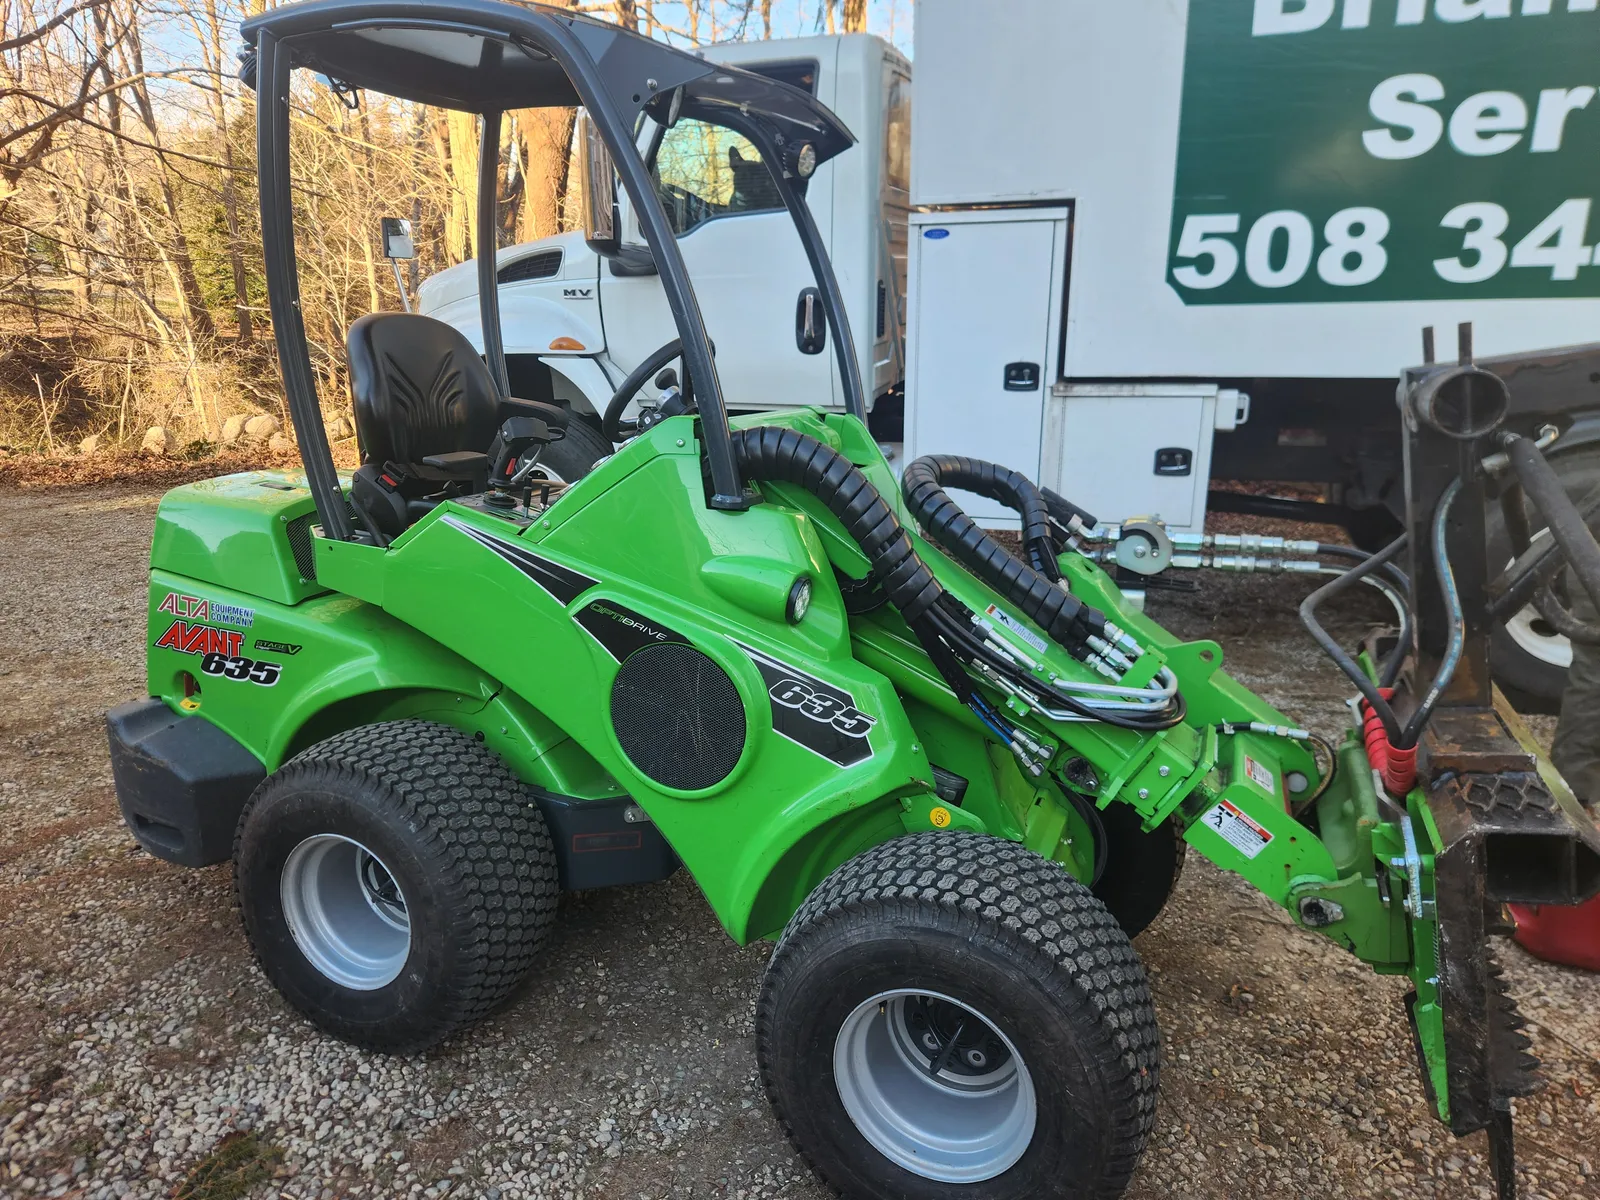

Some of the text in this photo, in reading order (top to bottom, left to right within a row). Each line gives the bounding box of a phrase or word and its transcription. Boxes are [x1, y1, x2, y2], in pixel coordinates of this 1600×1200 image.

[1362, 73, 1600, 160] Ser
[1172, 198, 1600, 289] 508 34
[563, 289, 592, 297] MV
[157, 592, 209, 621] ALTA
[211, 603, 254, 618] EQUIPMENT
[211, 613, 253, 628] COMPANY
[590, 603, 667, 640] OPTIDRIVE
[153, 619, 245, 658] AVANT
[201, 652, 283, 687] 635
[769, 679, 877, 738] 635
